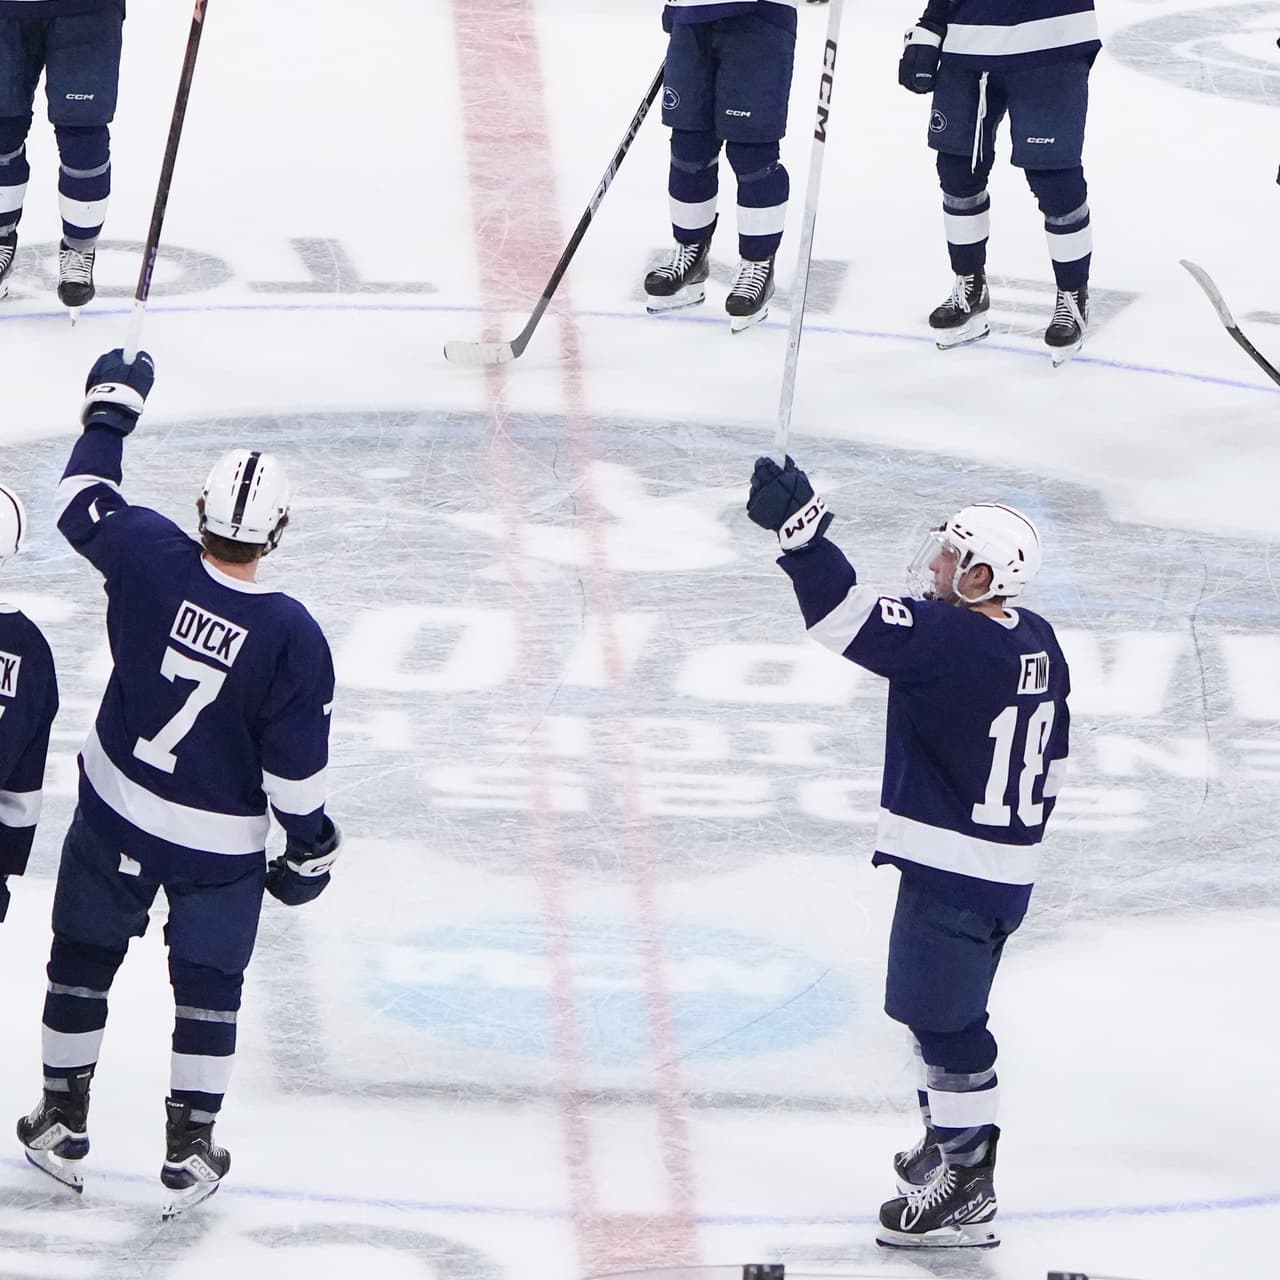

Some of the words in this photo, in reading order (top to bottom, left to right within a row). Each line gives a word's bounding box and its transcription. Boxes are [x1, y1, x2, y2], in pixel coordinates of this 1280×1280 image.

[65, 93, 95, 101] CCM
[726, 108, 752, 117] CCM
[814, 39, 838, 145] CCM
[230, 526, 240, 538] 7
[175, 605, 243, 662] DYCK
[133, 646, 227, 774] 7
[971, 701, 1056, 828] 18
[942, 1193, 984, 1225] CCM
